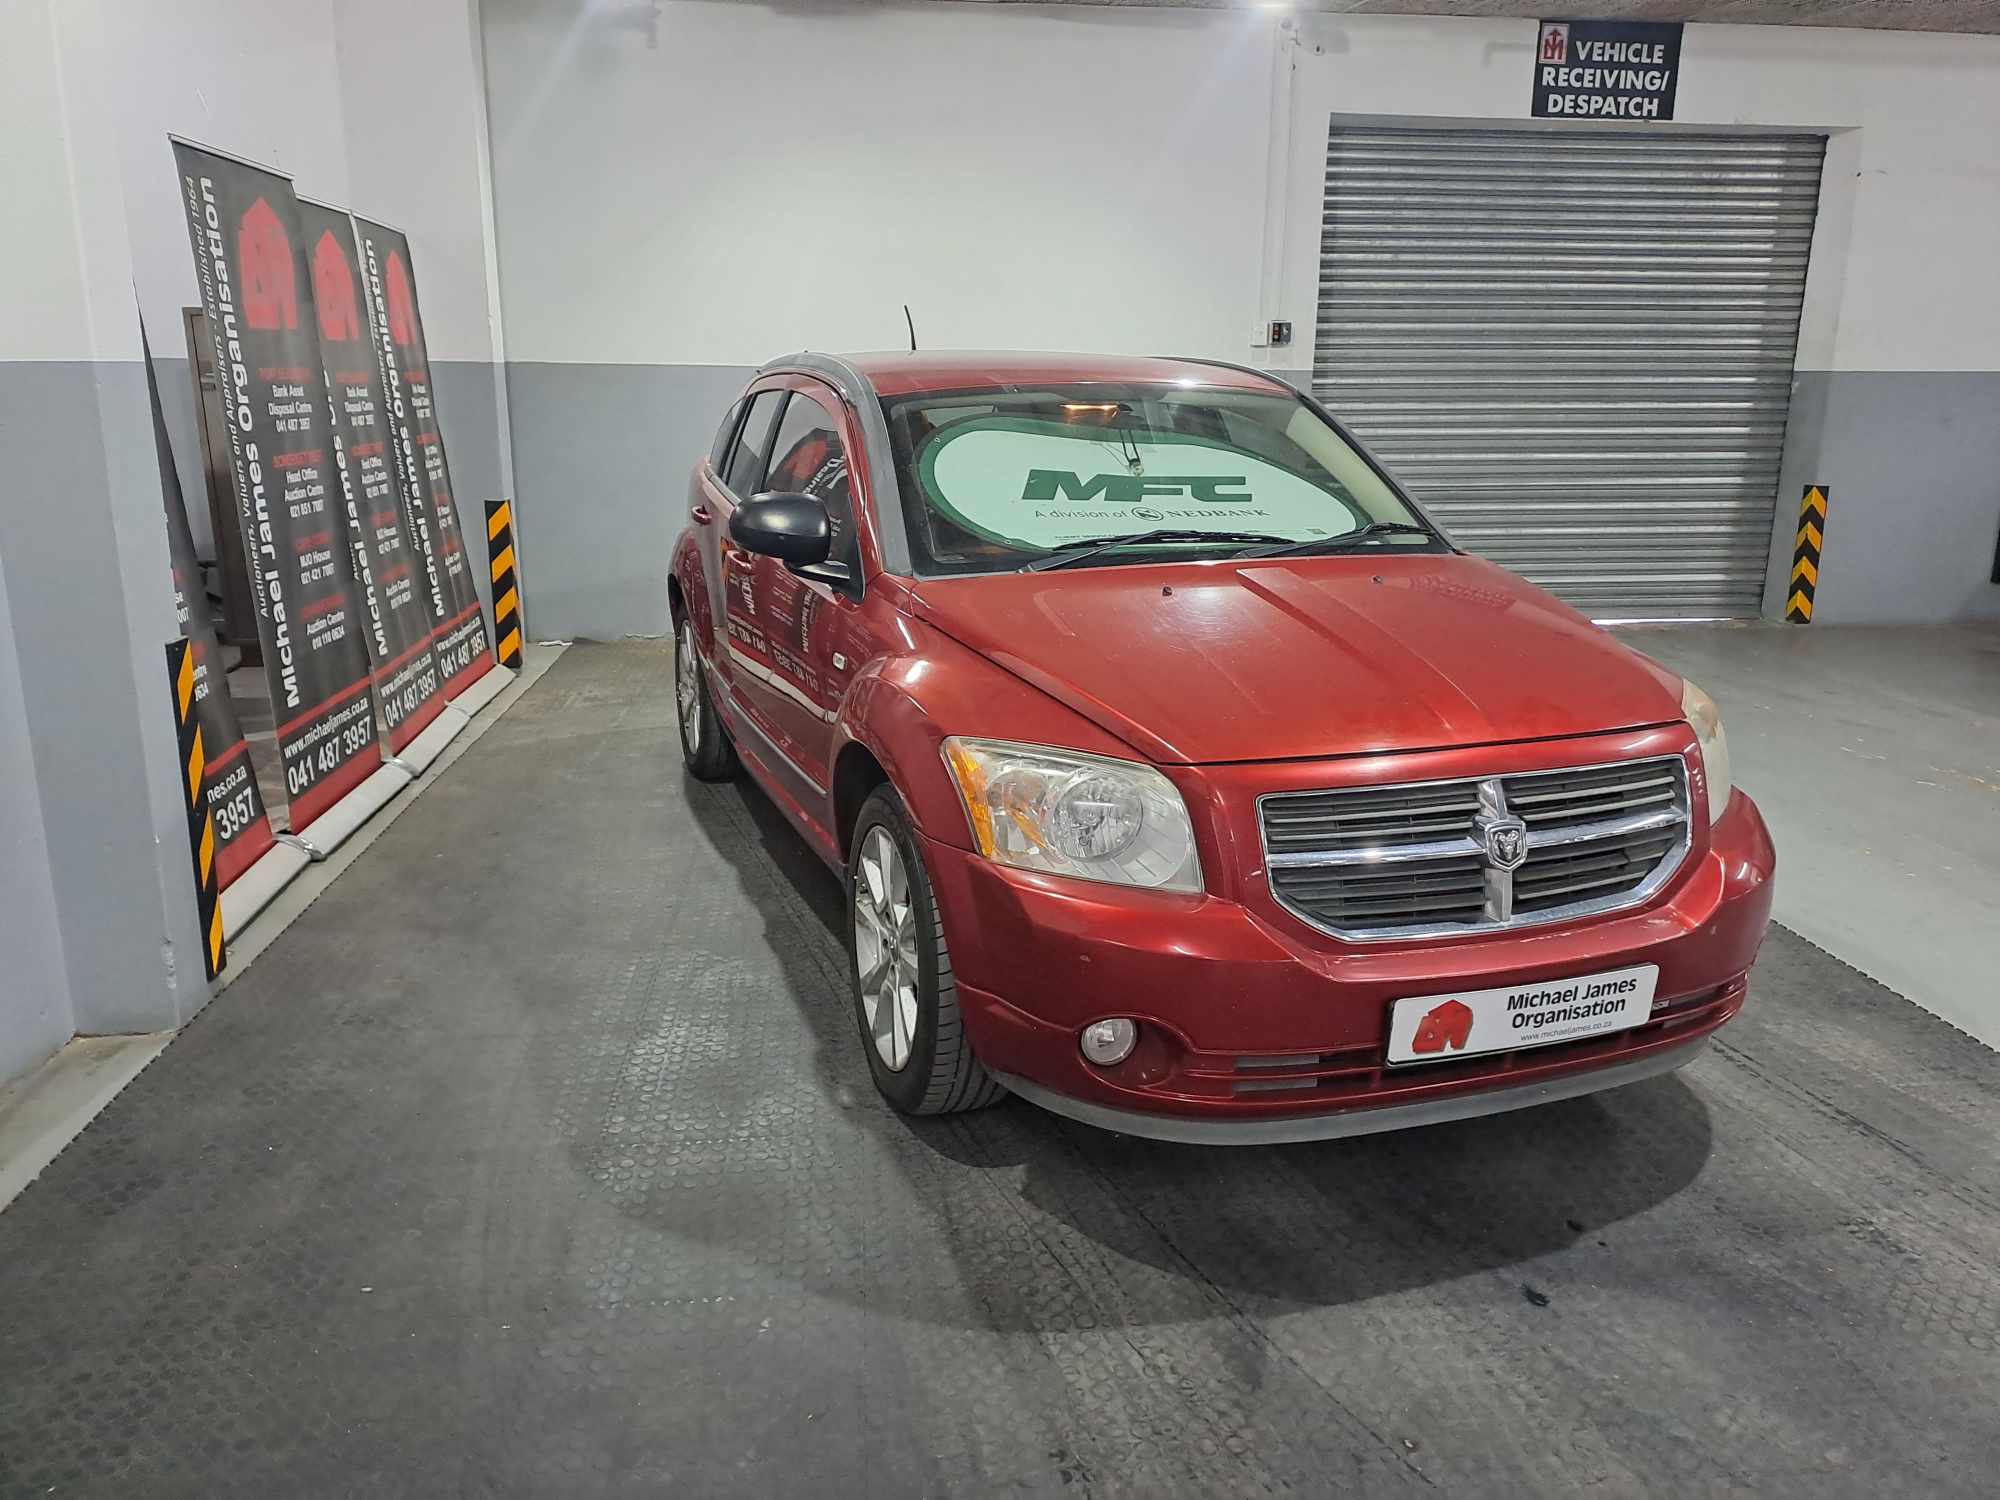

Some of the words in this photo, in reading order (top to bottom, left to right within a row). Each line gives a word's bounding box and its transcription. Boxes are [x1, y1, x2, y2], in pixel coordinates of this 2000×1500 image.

[1542, 66, 1671, 91] RECEIVING/
[1575, 41, 1665, 64] VEHICLE
[1547, 93, 1659, 117] DESPATCH
[185, 176, 200, 218] 1964
[193, 222, 217, 321] Established
[200, 177, 253, 432] Organisation
[366, 239, 404, 418] Organisation
[214, 334, 235, 421] Appraisers
[268, 402, 295, 417] Disposal
[228, 423, 241, 456] and
[400, 426, 423, 510] James
[236, 459, 251, 517] Valuers
[246, 442, 276, 560] James
[285, 488, 307, 502] Auction
[333, 435, 361, 533] James
[1022, 469, 1252, 502] MFC
[1035, 509, 1042, 518] A
[1049, 508, 1104, 519] division
[1107, 508, 1128, 518] of
[1166, 509, 1271, 519] NEDBANK
[248, 523, 269, 618] Auctioneers,
[417, 517, 444, 616] Michael
[354, 541, 388, 656] Michael
[265, 570, 300, 708] Michael
[440, 650, 458, 678] 041
[384, 695, 404, 728] 041
[403, 683, 419, 712] 487
[418, 667, 436, 700] 3957
[283, 696, 369, 759] www.michaeljames.co.za
[287, 754, 315, 795] 041
[318, 735, 340, 772] 487
[343, 714, 371, 755] 3957
[215, 785, 255, 840] 3957
[1507, 985, 1579, 1011] Michael
[1582, 978, 1637, 1000] James
[1511, 997, 1626, 1029] Organisation
[1520, 1020, 1613, 1041] www.michaeljames.co.za
